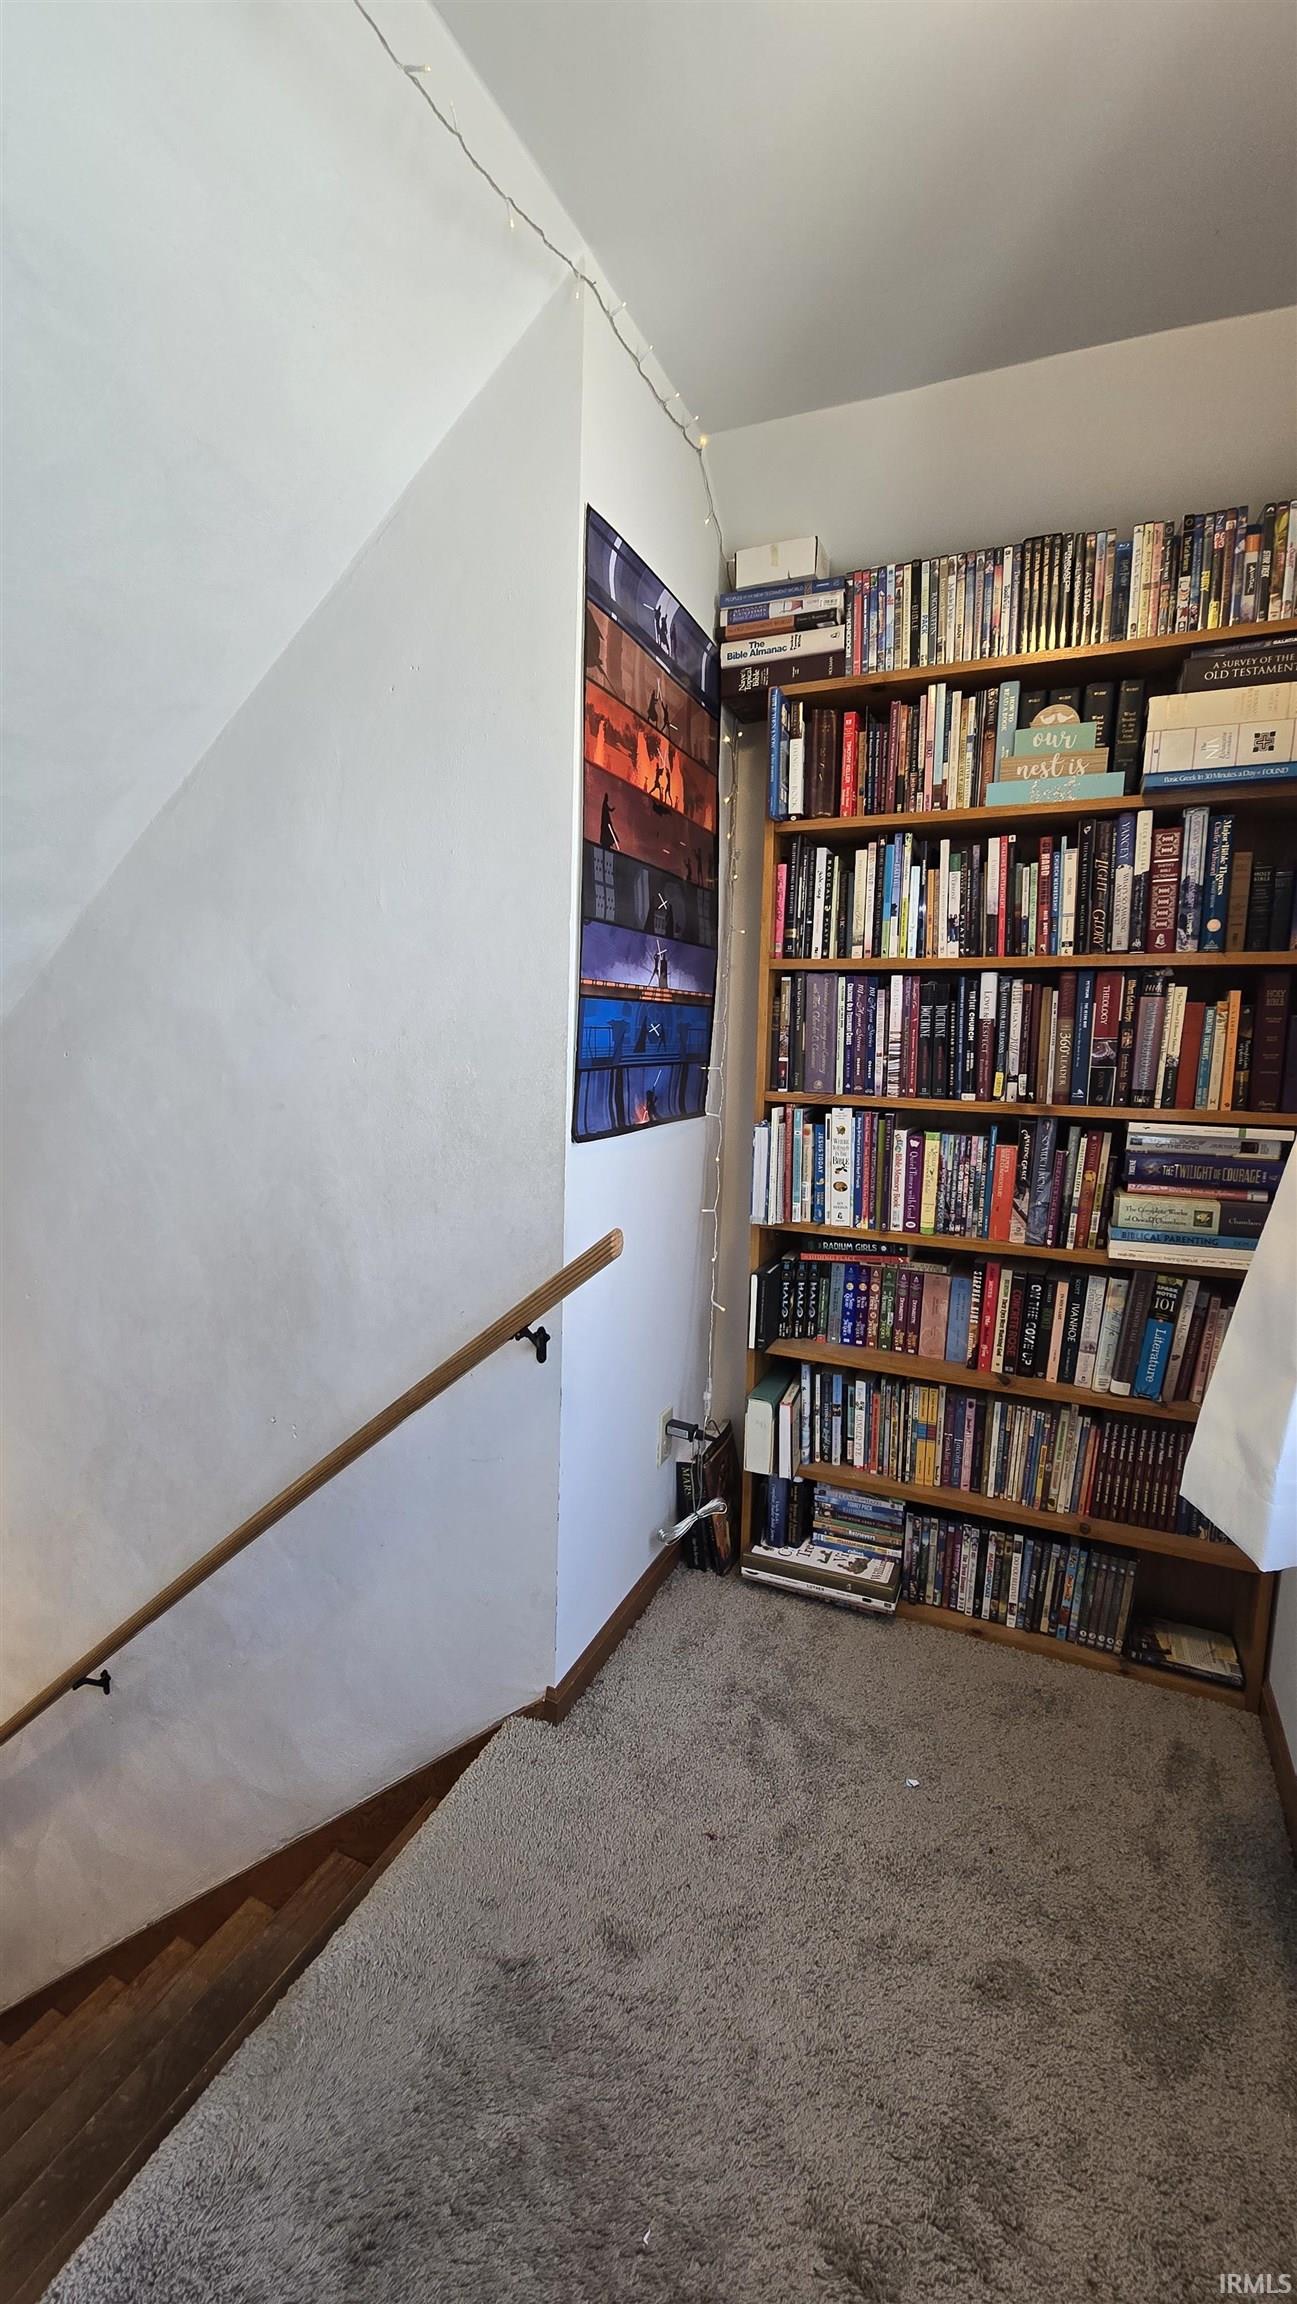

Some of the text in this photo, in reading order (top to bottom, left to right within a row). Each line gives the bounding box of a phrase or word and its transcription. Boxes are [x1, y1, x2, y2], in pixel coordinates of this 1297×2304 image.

[1064, 540, 1073, 593] TERMINATOR
[1260, 550, 1271, 578] STAR TREK
[1200, 570, 1211, 592] FURY
[1083, 588, 1091, 616] STAND
[727, 645, 788, 661] Bible Almanac
[749, 641, 765, 649] The
[1222, 658, 1256, 668] SURVEY
[1259, 656, 1272, 664] OF
[1275, 653, 1295, 662] THE
[1203, 669, 1230, 681] OLD
[1008, 696, 1016, 723] HOW TO
[1032, 730, 1077, 749] our
[1016, 752, 1090, 780] nest is
[1178, 774, 1197, 783] Greek
[1204, 772, 1212, 780] 30
[1212, 771, 1238, 780] Minutes
[1242, 769, 1256, 778] Day
[1119, 821, 1130, 860] YANCEY
[1040, 853, 1050, 877] HARD
[1215, 819, 1232, 896] Major Bible Themes
[1122, 873, 1130, 895] WHAT'S
[1092, 859, 1110, 947] LIGHT GLORY
[1120, 904, 1128, 933] AMAZING
[867, 997, 876, 1023] Hymn
[1000, 992, 1008, 1008] FAITH
[1100, 985, 1111, 1025] THEOLOGY
[1124, 979, 1137, 1023] When God Weeps
[855, 1001, 864, 1028] Hymn
[920, 1005, 933, 1038] DOCTRINE
[935, 1005, 948, 1038] DOCTRINE
[968, 1012, 976, 1041] CHURCH
[981, 990, 992, 1054] LOVE RESPECT
[999, 1020, 1007, 1030] ALL
[1203, 1009, 1214, 1034] MOUNTAIN
[856, 1028, 864, 1052] Stories
[867, 1024, 876, 1048] Stories
[998, 1032, 1006, 1054] SEASONS
[1058, 1055, 1068, 1086] LEADER
[1020, 1129, 1031, 1181] AMAZING GRACE
[1074, 1141, 1086, 1193] CHRISTIAN BELIEFS
[893, 1153, 903, 1208] Bible Memory Book
[907, 1151, 918, 1219] Quiet Times with God
[1162, 1165, 1174, 1176] THE
[1174, 1163, 1214, 1180] TWILIGHT
[1221, 1167, 1262, 1184] COURAGE
[1228, 1218, 1262, 1227] Chambers
[822, 1241, 878, 1252] RADIUM GIRLS
[1121, 1230, 1219, 1246] BIBLICAL PARENTING
[781, 1281, 790, 1318] HALO
[796, 1281, 805, 1318] HALO
[808, 1281, 817, 1318] HALO
[969, 1271, 982, 1324] STEPHEN KING
[1001, 1298, 1009, 1309] Their
[1029, 1284, 1042, 1299] ON
[1154, 1297, 1175, 1313] 101
[1000, 1309, 1008, 1319] Eyes
[1006, 1289, 1023, 1358] CONCRETE ROSE
[1027, 1301, 1039, 1320] THE
[1066, 1302, 1079, 1343] IVANHOE
[997, 1329, 1005, 1347] Watching
[1022, 1322, 1037, 1350] COME
[1145, 1327, 1166, 1383] Literature
[944, 1432, 953, 1461] Franklin
[954, 1438, 964, 1464] Lincoln
[848, 1529, 876, 1541] Retrievers
[985, 1573, 993, 1598] CUPCAKE
